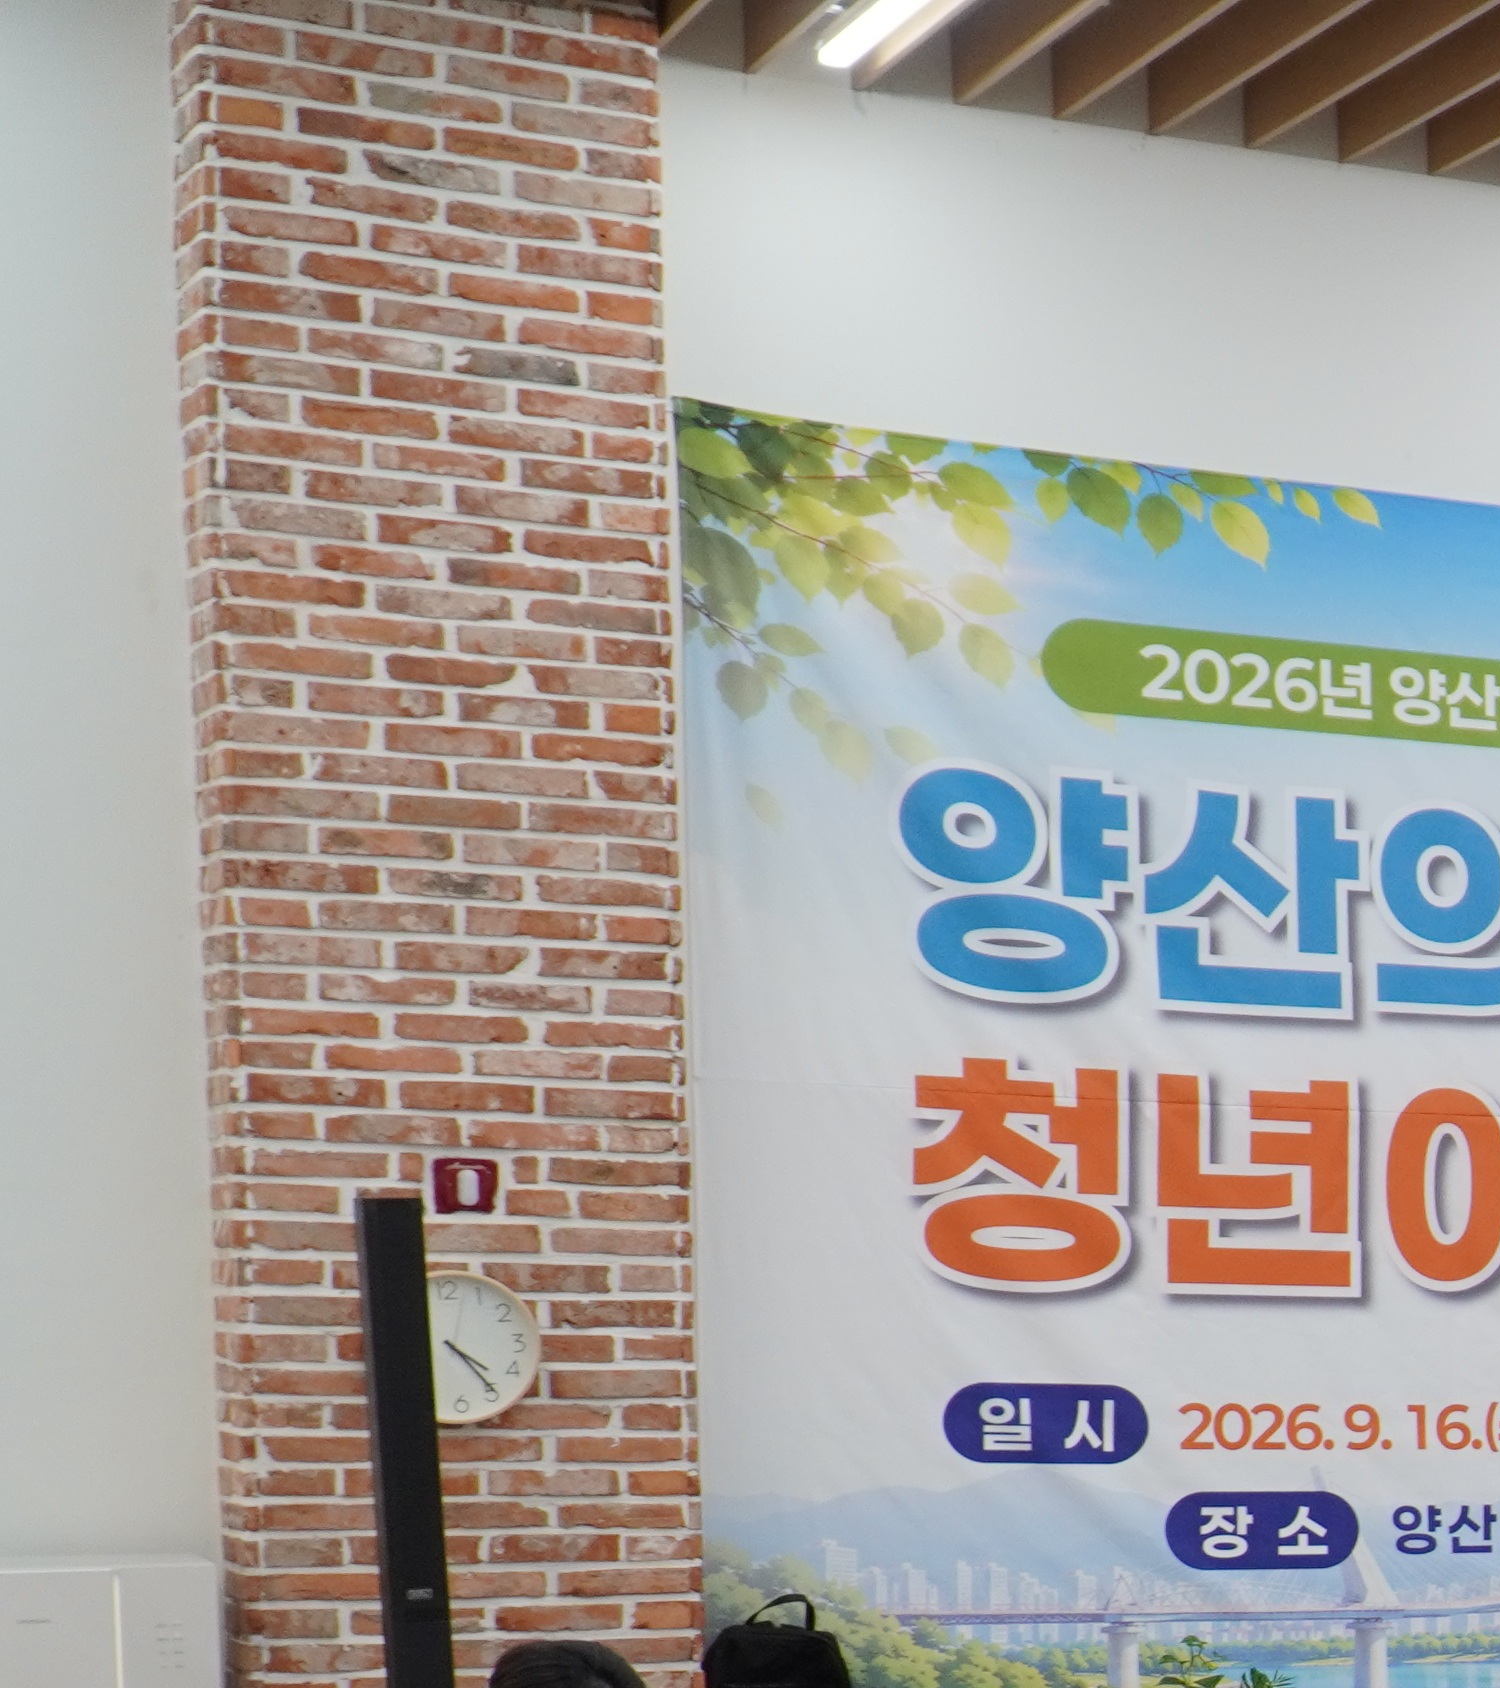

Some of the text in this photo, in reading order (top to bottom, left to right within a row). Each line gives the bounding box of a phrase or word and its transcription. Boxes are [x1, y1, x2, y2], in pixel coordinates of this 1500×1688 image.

[1139, 642, 1375, 723] 2026년
[436, 1280, 459, 1300] 12
[475, 1287, 482, 1305] 1
[496, 1303, 513, 1323] 2
[512, 1333, 527, 1353] 3
[506, 1360, 520, 1377] 4
[484, 1382, 500, 1403] 5
[454, 1395, 470, 1414] 6
[980, 1397, 1116, 1452] 일 시
[1181, 1403, 1334, 1450] 2026.
[1345, 1404, 1391, 1450] 9.
[1200, 1506, 1330, 1558] 장 소
